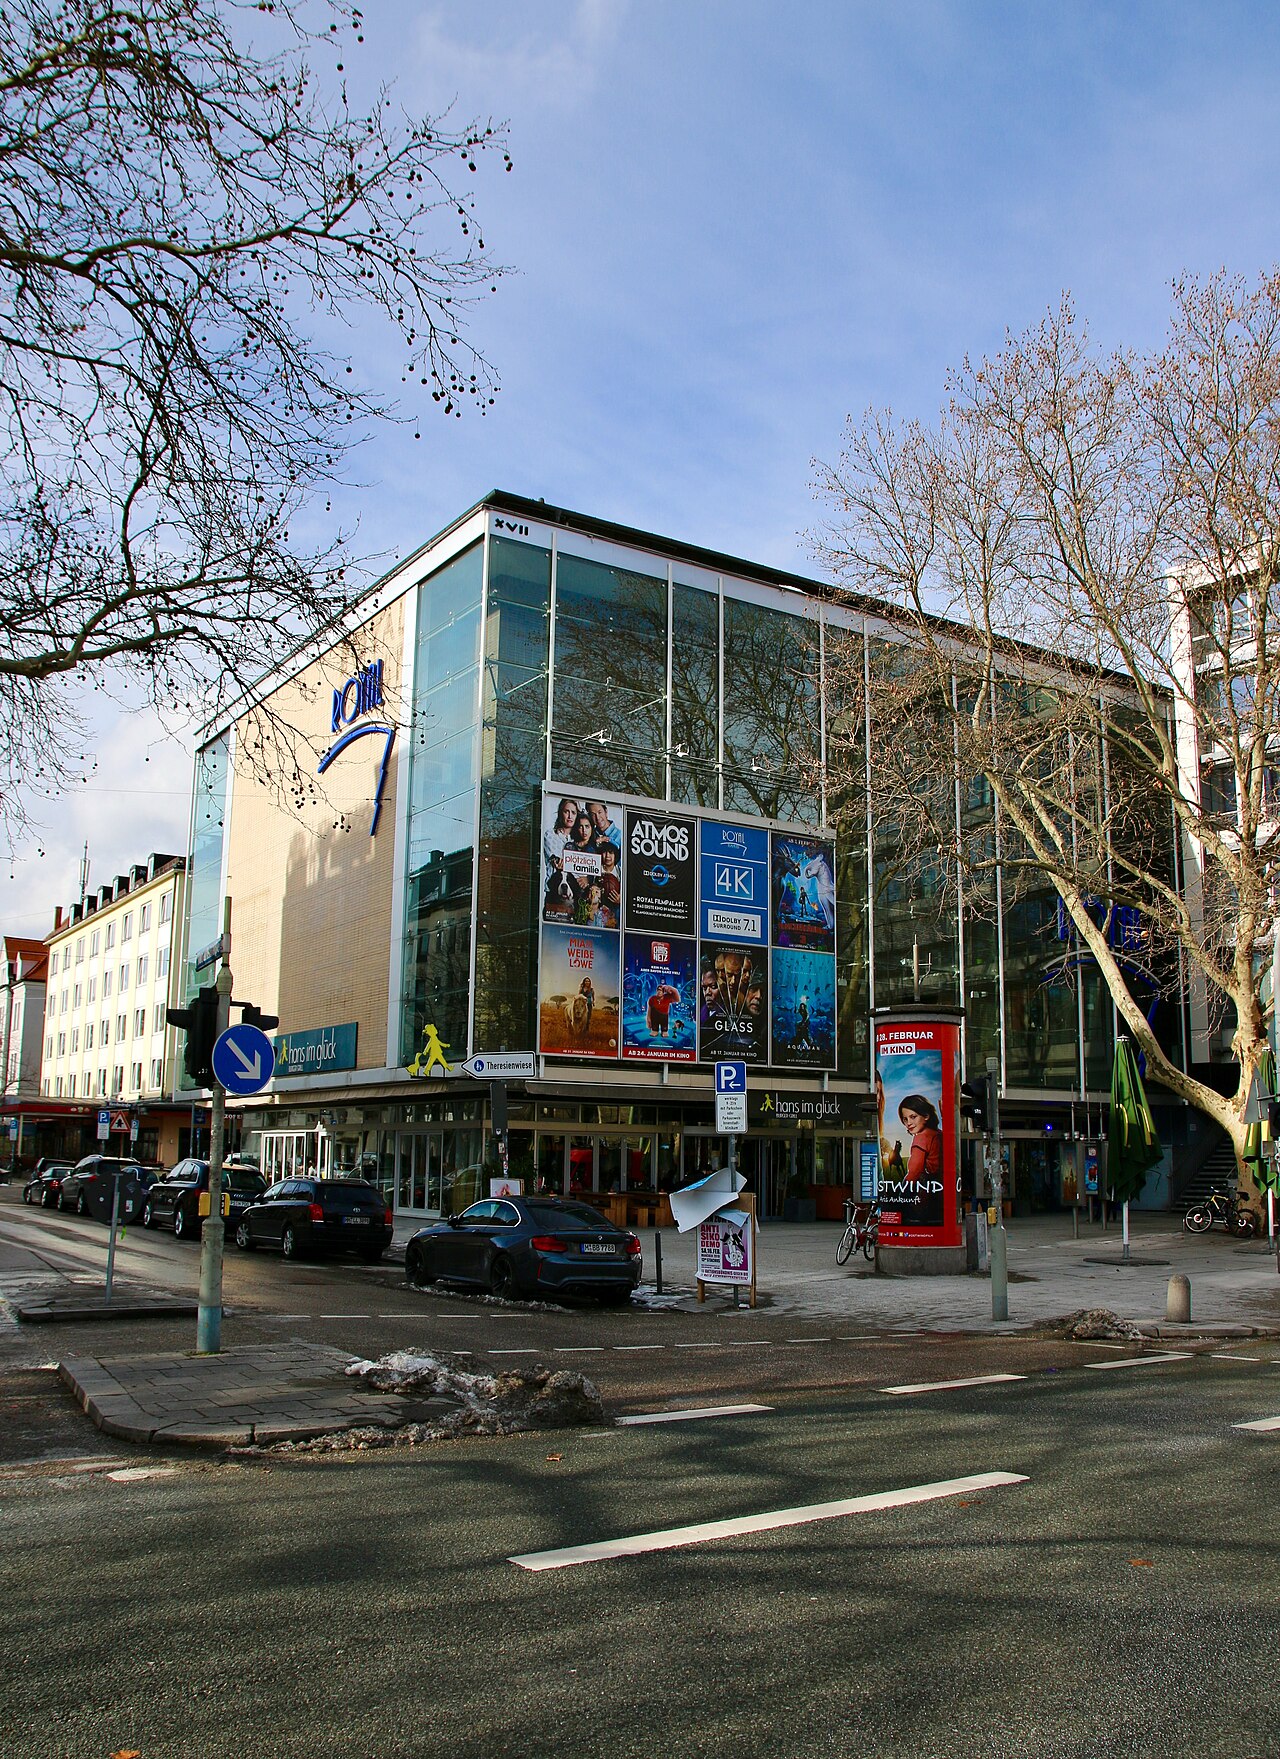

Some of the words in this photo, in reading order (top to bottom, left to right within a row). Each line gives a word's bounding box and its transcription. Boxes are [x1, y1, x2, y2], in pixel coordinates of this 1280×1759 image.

[494, 517, 529, 536] XVII
[631, 820, 689, 845] ATMOS
[631, 837, 690, 861] SOUND
[565, 855, 597, 866] plötzlich
[573, 864, 600, 874] familie
[718, 868, 750, 895] 4K
[636, 896, 654, 904] ROYAL
[655, 898, 684, 908] FILMPALAST
[712, 922, 742, 931] SURROUND
[743, 918, 756, 932] 7.1
[570, 958, 592, 969] LÖWE
[654, 954, 668, 962] NETZ
[715, 1020, 753, 1033] GLASS
[889, 1032, 934, 1040] FEBRUAR
[288, 1035, 306, 1064] hans
[306, 1042, 315, 1061] im
[316, 1028, 336, 1069] glück
[890, 1046, 912, 1054] KINO
[486, 1060, 532, 1070] Theresienwiese
[721, 1066, 737, 1089] P
[776, 1093, 799, 1113] hans
[802, 1100, 814, 1113] im
[816, 1094, 840, 1119] glück
[888, 1195, 921, 1205] Ankunft
